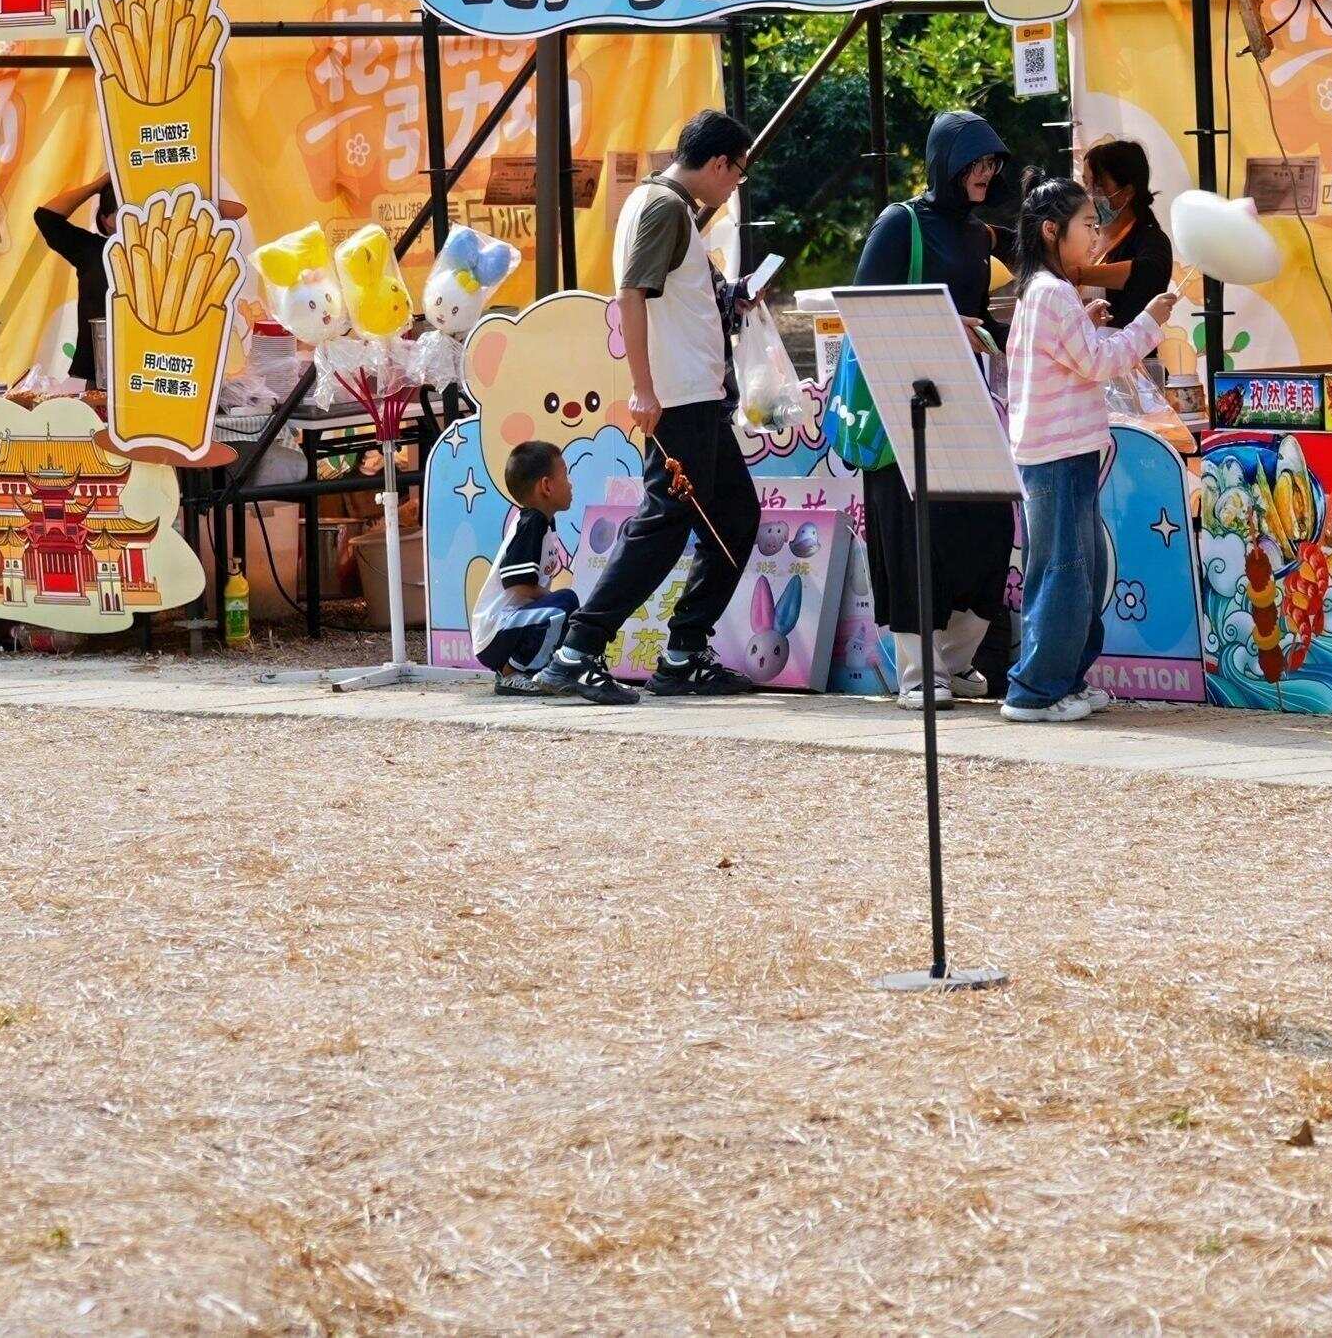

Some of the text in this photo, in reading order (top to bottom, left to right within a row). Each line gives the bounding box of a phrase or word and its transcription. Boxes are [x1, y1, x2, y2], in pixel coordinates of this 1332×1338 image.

[140, 123, 190, 143] 用心做好
[130, 146, 197, 166] 每一根薯条！
[143, 353, 194, 374] 用心做好
[130, 374, 197, 397] 每一根薯条！
[1249, 379, 1316, 413] 孜然烤肉
